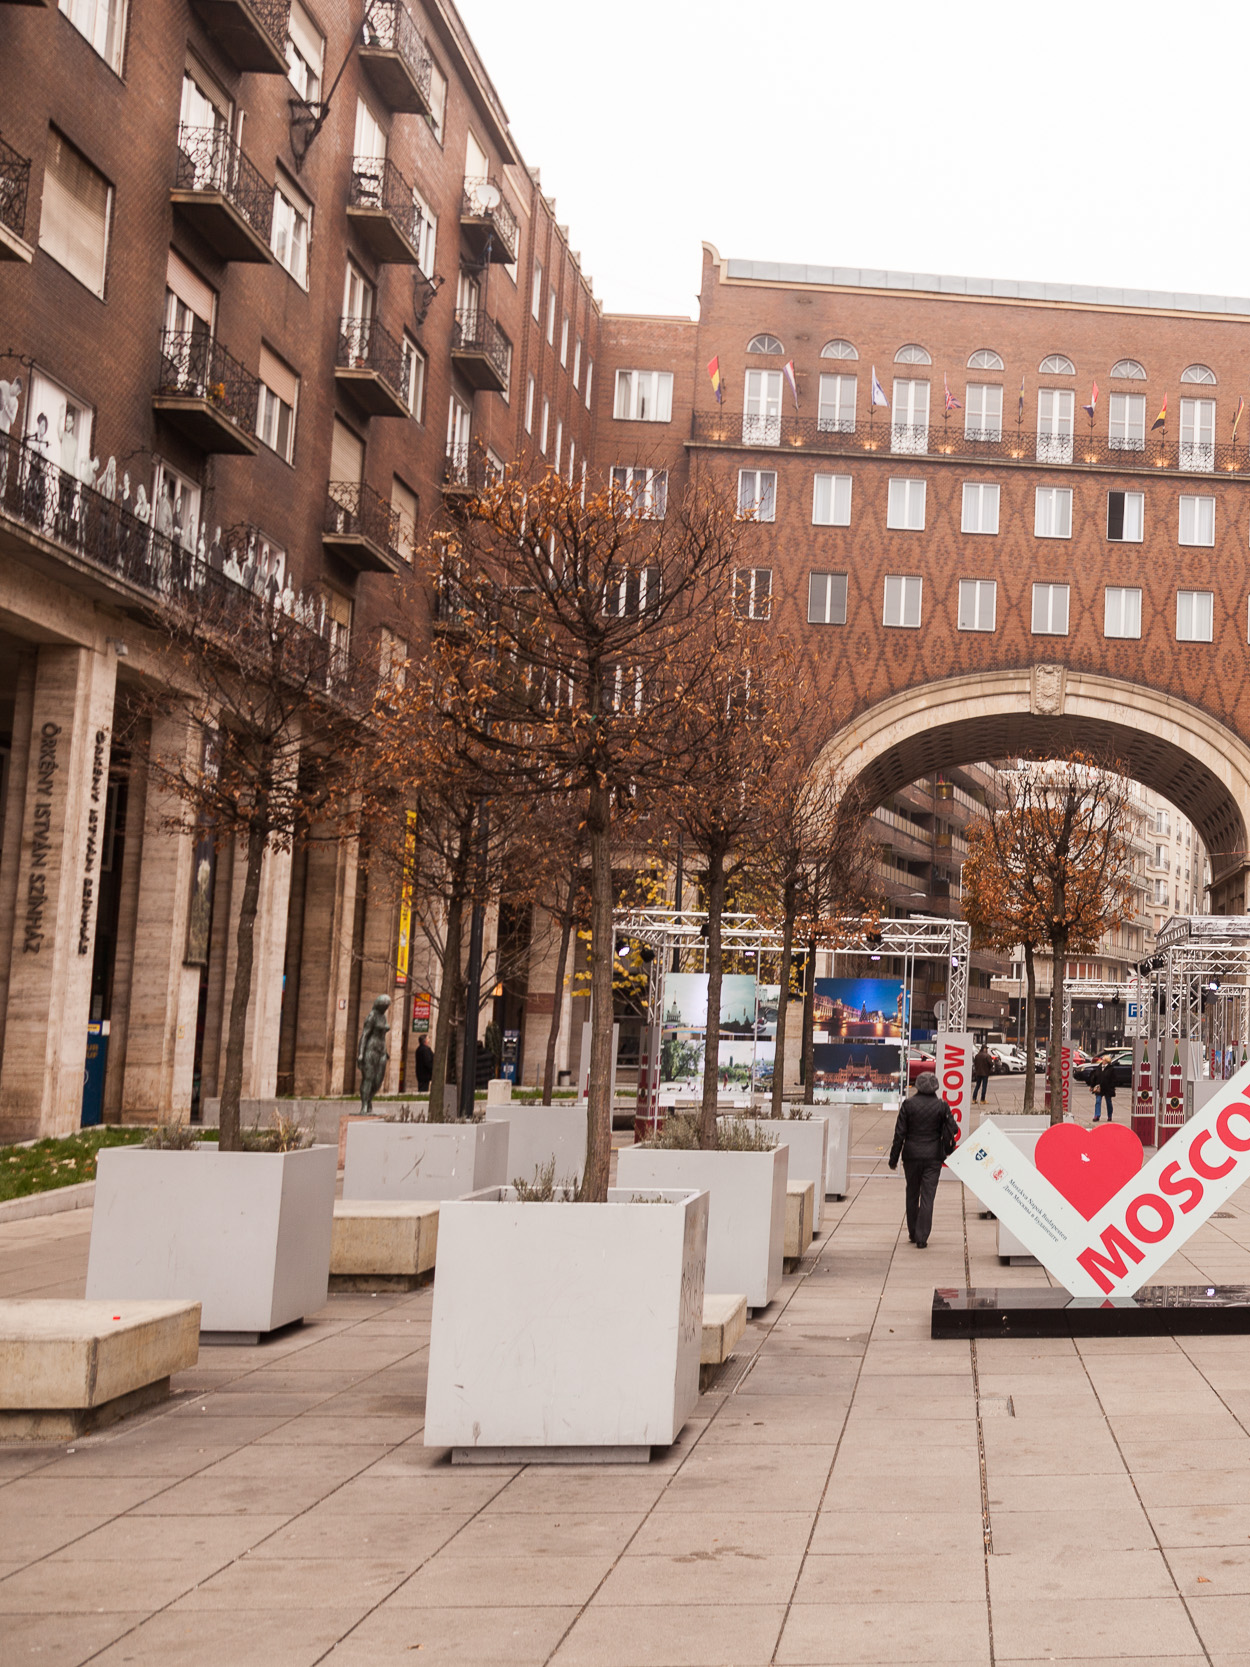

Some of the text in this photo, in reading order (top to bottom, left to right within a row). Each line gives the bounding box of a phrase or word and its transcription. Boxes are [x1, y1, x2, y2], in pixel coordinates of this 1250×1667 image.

[22, 721, 62, 955] ÖRKÉNY ISTVÁN SZÍNHÁZ
